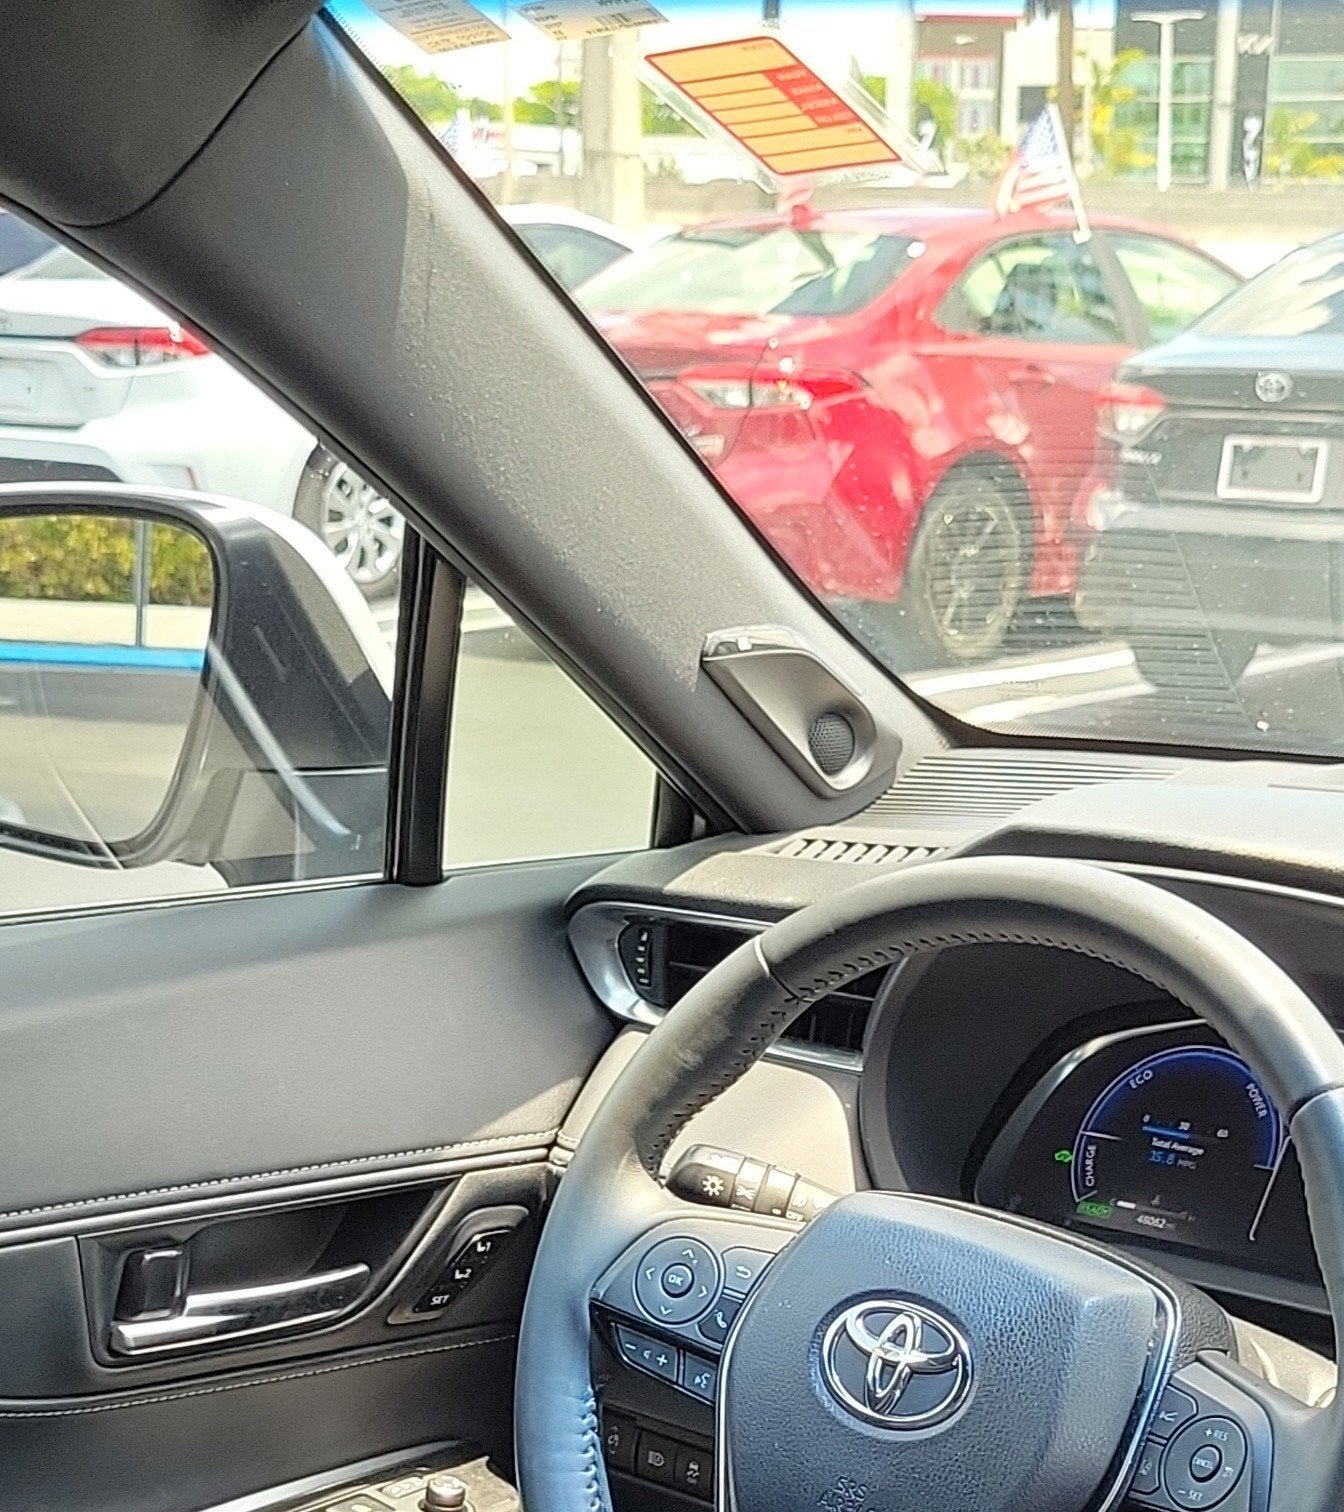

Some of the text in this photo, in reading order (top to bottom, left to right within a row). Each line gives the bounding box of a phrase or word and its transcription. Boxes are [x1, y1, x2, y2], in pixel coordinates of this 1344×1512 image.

[1129, 1069, 1154, 1089] ECO
[1245, 1082, 1269, 1119] POWER
[1085, 1144, 1097, 1187] CHARGE
[668, 1274, 684, 1286] OK
